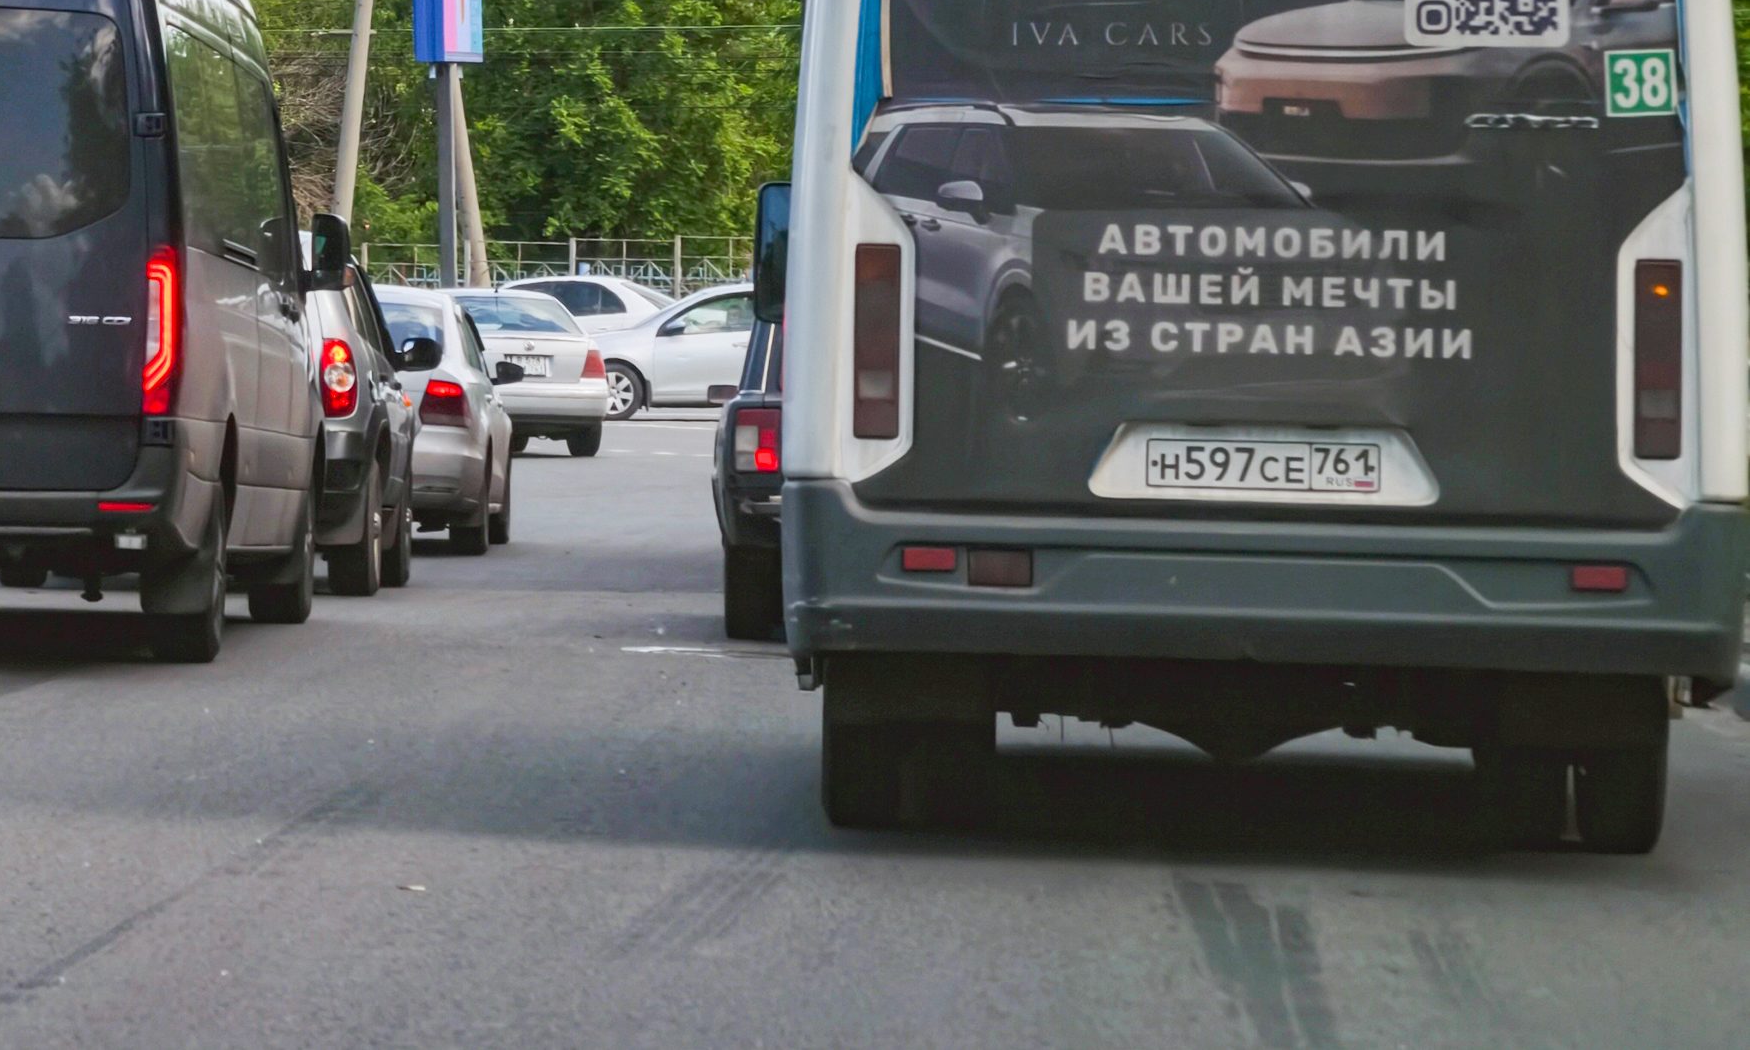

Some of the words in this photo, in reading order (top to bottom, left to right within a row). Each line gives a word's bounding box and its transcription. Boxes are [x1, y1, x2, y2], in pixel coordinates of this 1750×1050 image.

[1012, 23, 1079, 46] IVA
[1104, 23, 1213, 46] CARS
[1613, 57, 1668, 108] 38
[1098, 224, 1447, 260] АВТОМОБИЛИ
[1083, 267, 1260, 304] ВАШЕЙ
[1282, 278, 1457, 309] МЕЧТЫ
[1066, 320, 1131, 349] ИЗ
[1150, 322, 1313, 354] СТРАН
[1334, 327, 1472, 359] АЗИИ
[1314, 447, 1371, 477] 761
[1325, 476, 1353, 487] RUS
